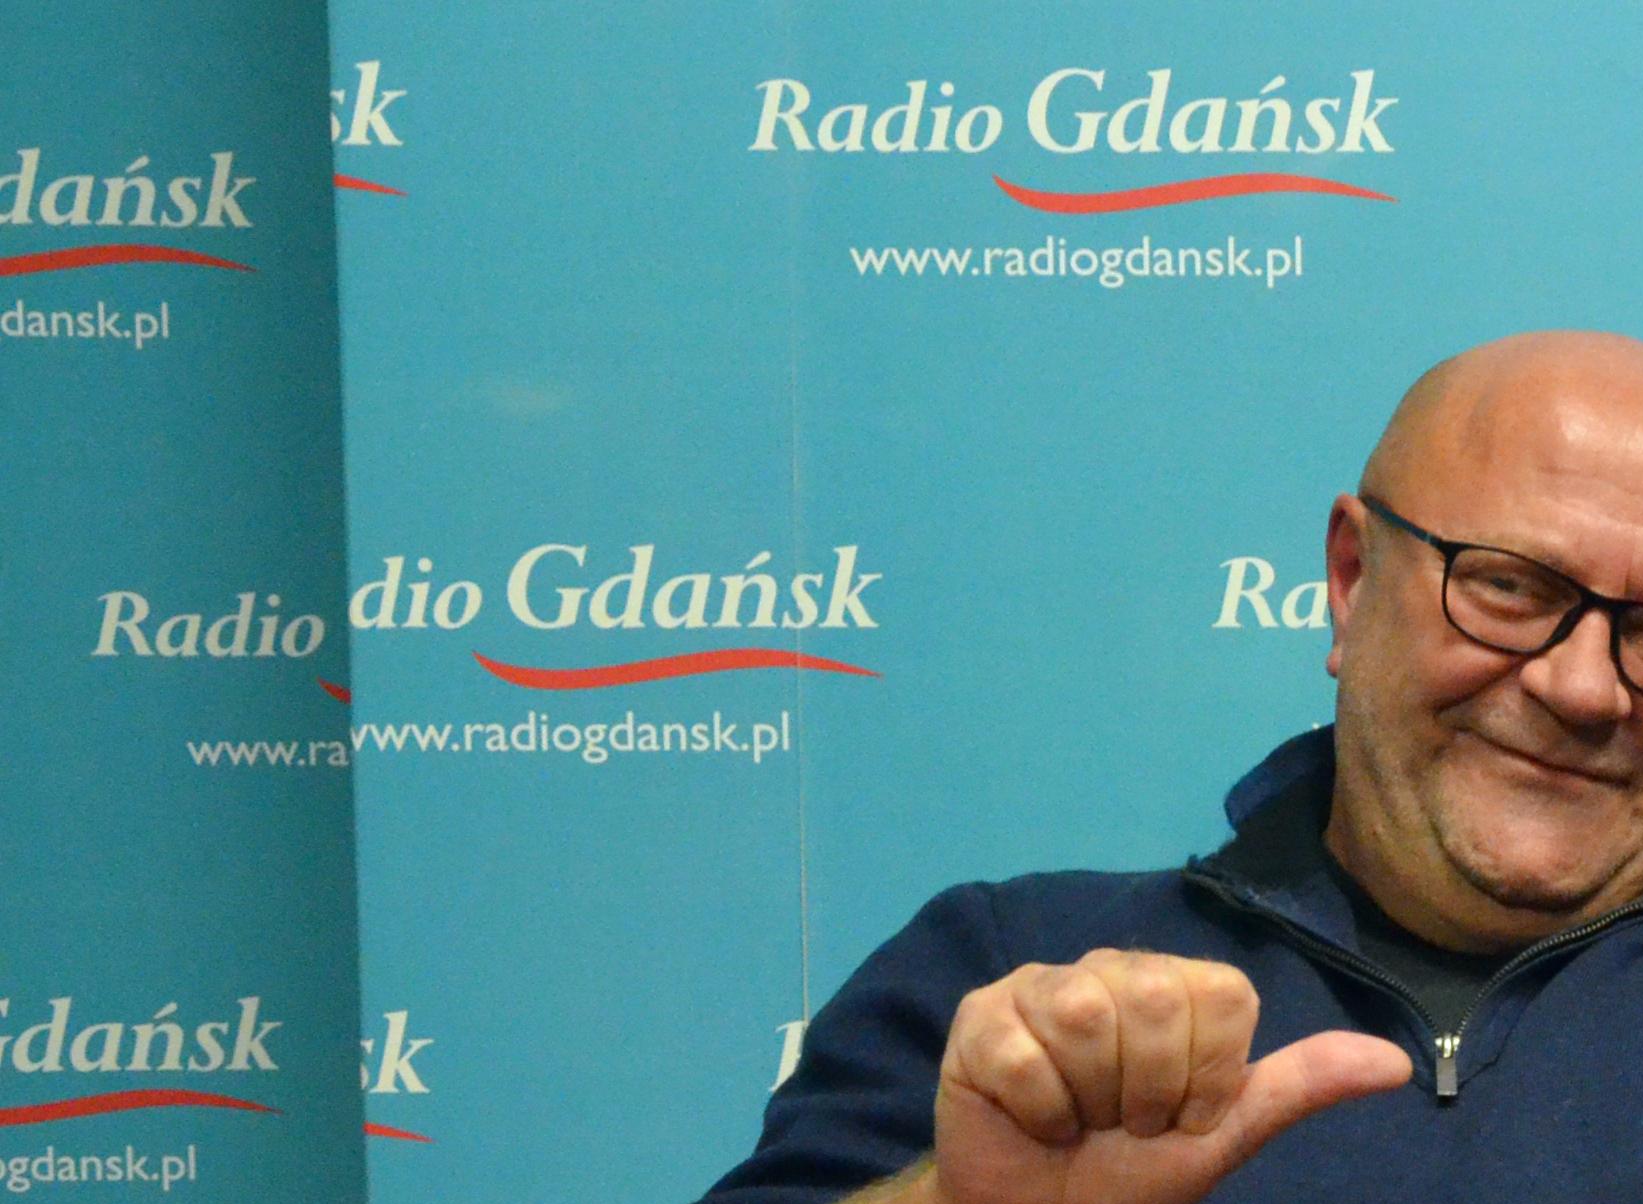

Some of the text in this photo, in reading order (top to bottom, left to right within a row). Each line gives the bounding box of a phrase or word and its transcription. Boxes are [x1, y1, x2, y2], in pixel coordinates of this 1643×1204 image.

[750, 68, 1398, 154] Radio Gdańsk
[0, 148, 254, 227] dańsk
[850, 235, 1302, 288] www.radiogdansk.pl
[0, 300, 169, 349] dansk.pl
[349, 544, 882, 629] dio Gdańsk
[92, 591, 324, 657] Radio
[0, 996, 281, 1073] dańsk
[0, 1145, 196, 1193] gdansk.pl
